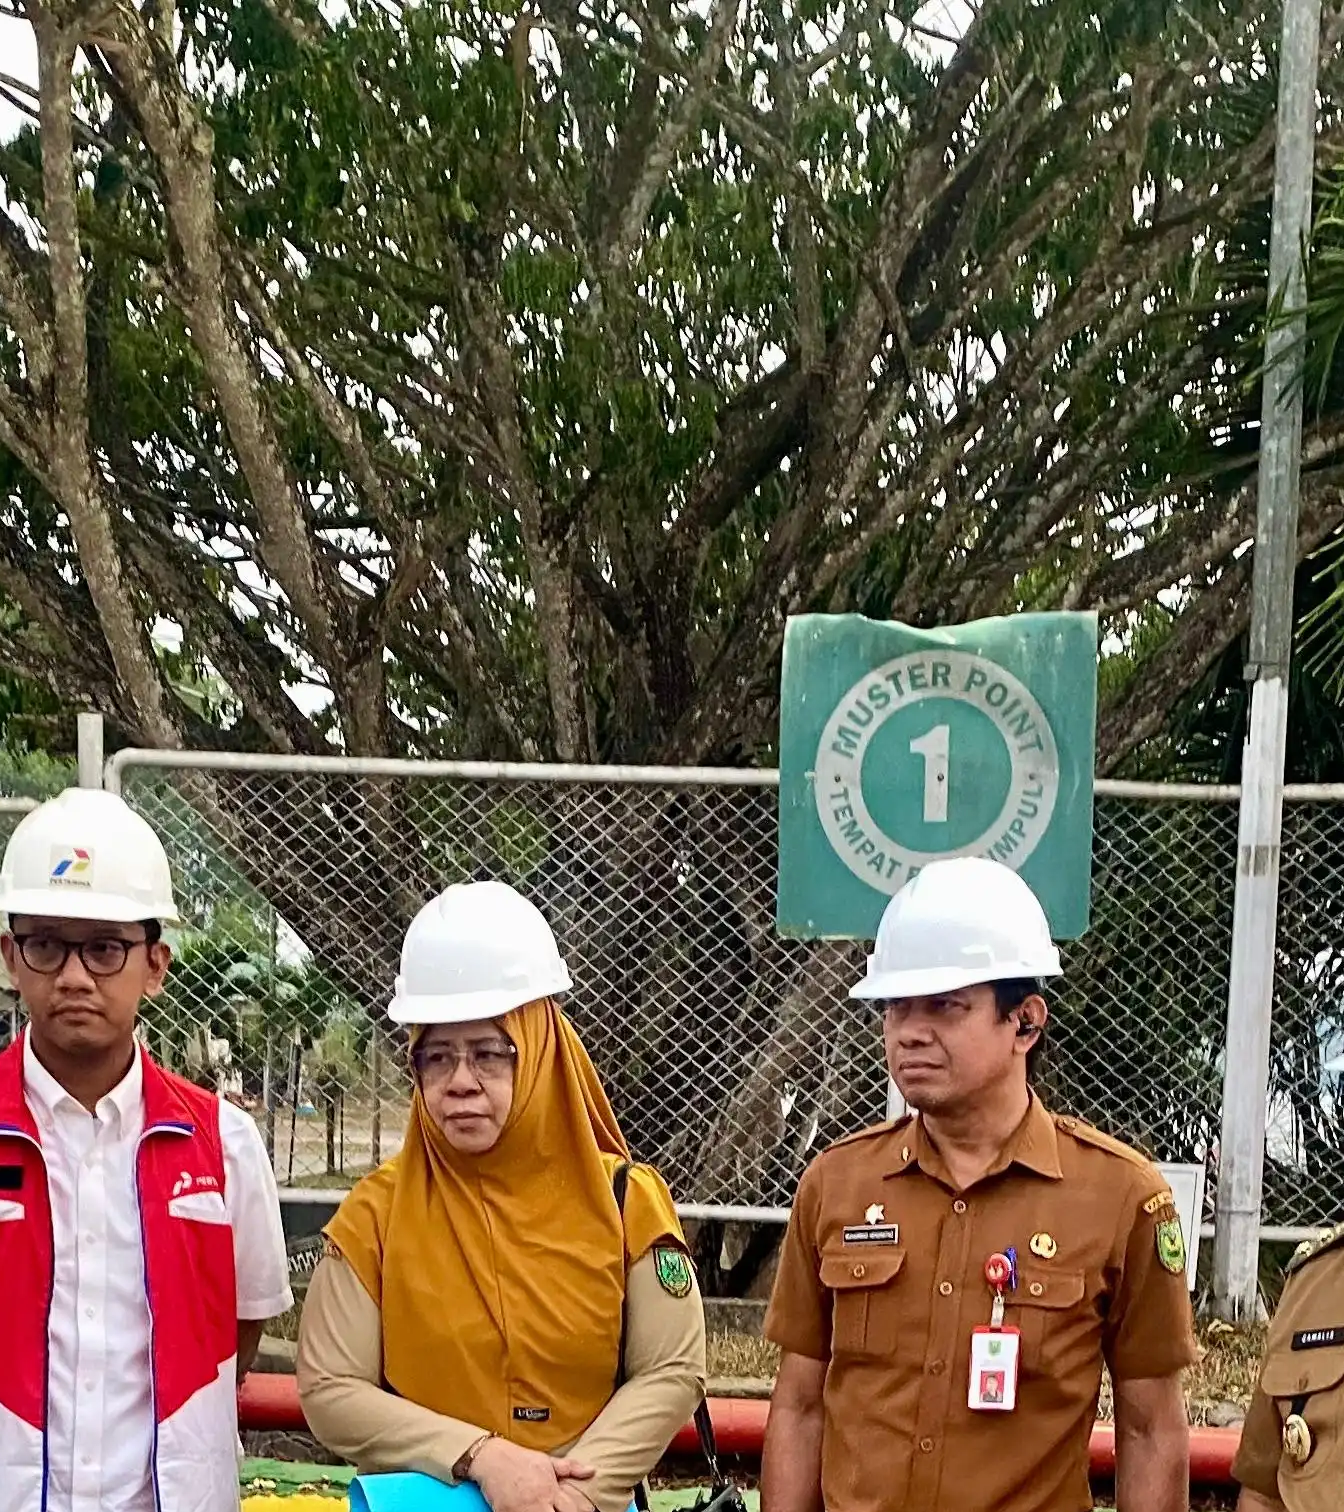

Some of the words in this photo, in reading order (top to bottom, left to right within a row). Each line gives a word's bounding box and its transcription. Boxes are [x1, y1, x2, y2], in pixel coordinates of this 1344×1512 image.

[831, 661, 952, 760] MUSTER
[964, 668, 1044, 754] POINT
[909, 724, 951, 823] 1
[829, 786, 902, 880] TEMPAT
